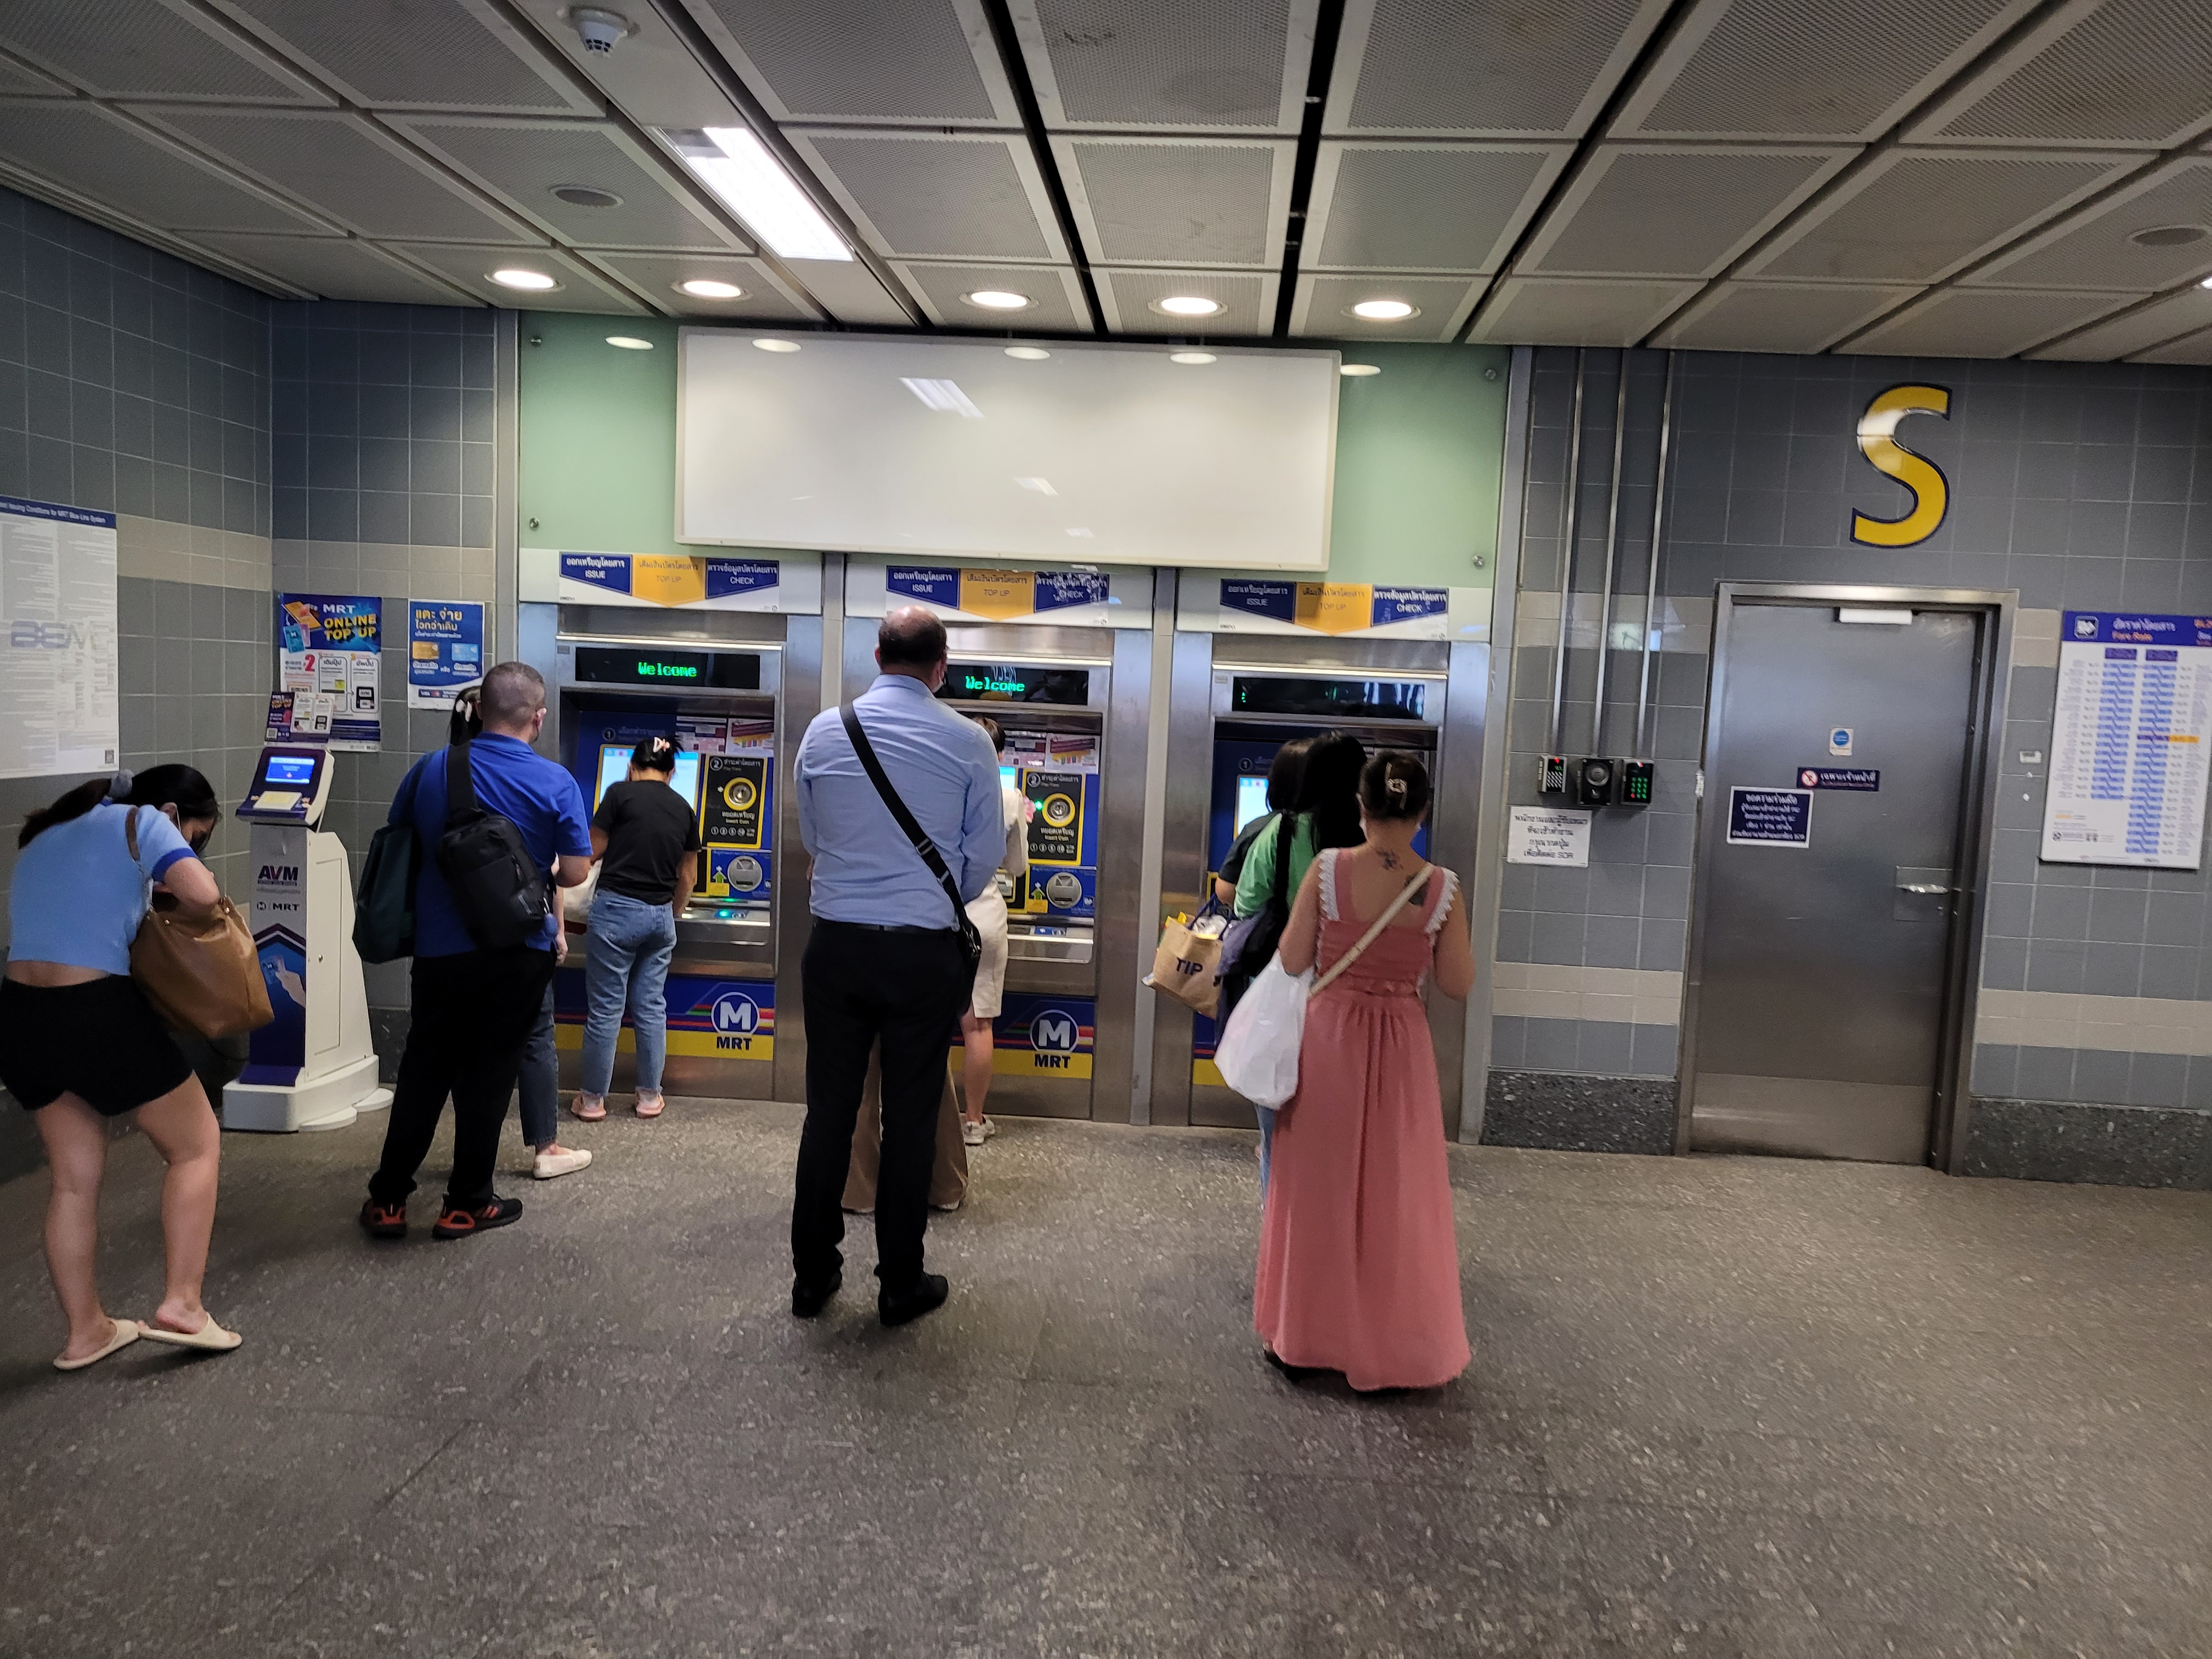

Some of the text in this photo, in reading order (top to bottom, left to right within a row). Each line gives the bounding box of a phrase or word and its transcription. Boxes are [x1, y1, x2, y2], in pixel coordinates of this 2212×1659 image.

[1850, 382, 1952, 549] S
[585, 569, 606, 579] ISSUE
[730, 576, 755, 585] CHECK
[912, 584, 933, 594] ISSUE
[323, 604, 356, 614] MRT
[1247, 598, 1268, 606] ISSUE
[324, 614, 376, 628] ONLINE
[439, 606, 462, 621] จ่าย
[324, 627, 376, 641] TOP UP
[304, 654, 315, 672] 2
[638, 662, 697, 677] Welcome
[966, 676, 1025, 691] Welcome
[258, 865, 298, 881] AVM
[273, 902, 300, 911] MRT
[1176, 957, 1203, 975] TIP
[719, 1001, 752, 1031] M
[1038, 1019, 1070, 1048] M
[716, 1036, 753, 1051] MRT
[1034, 1054, 1071, 1069] MRT
